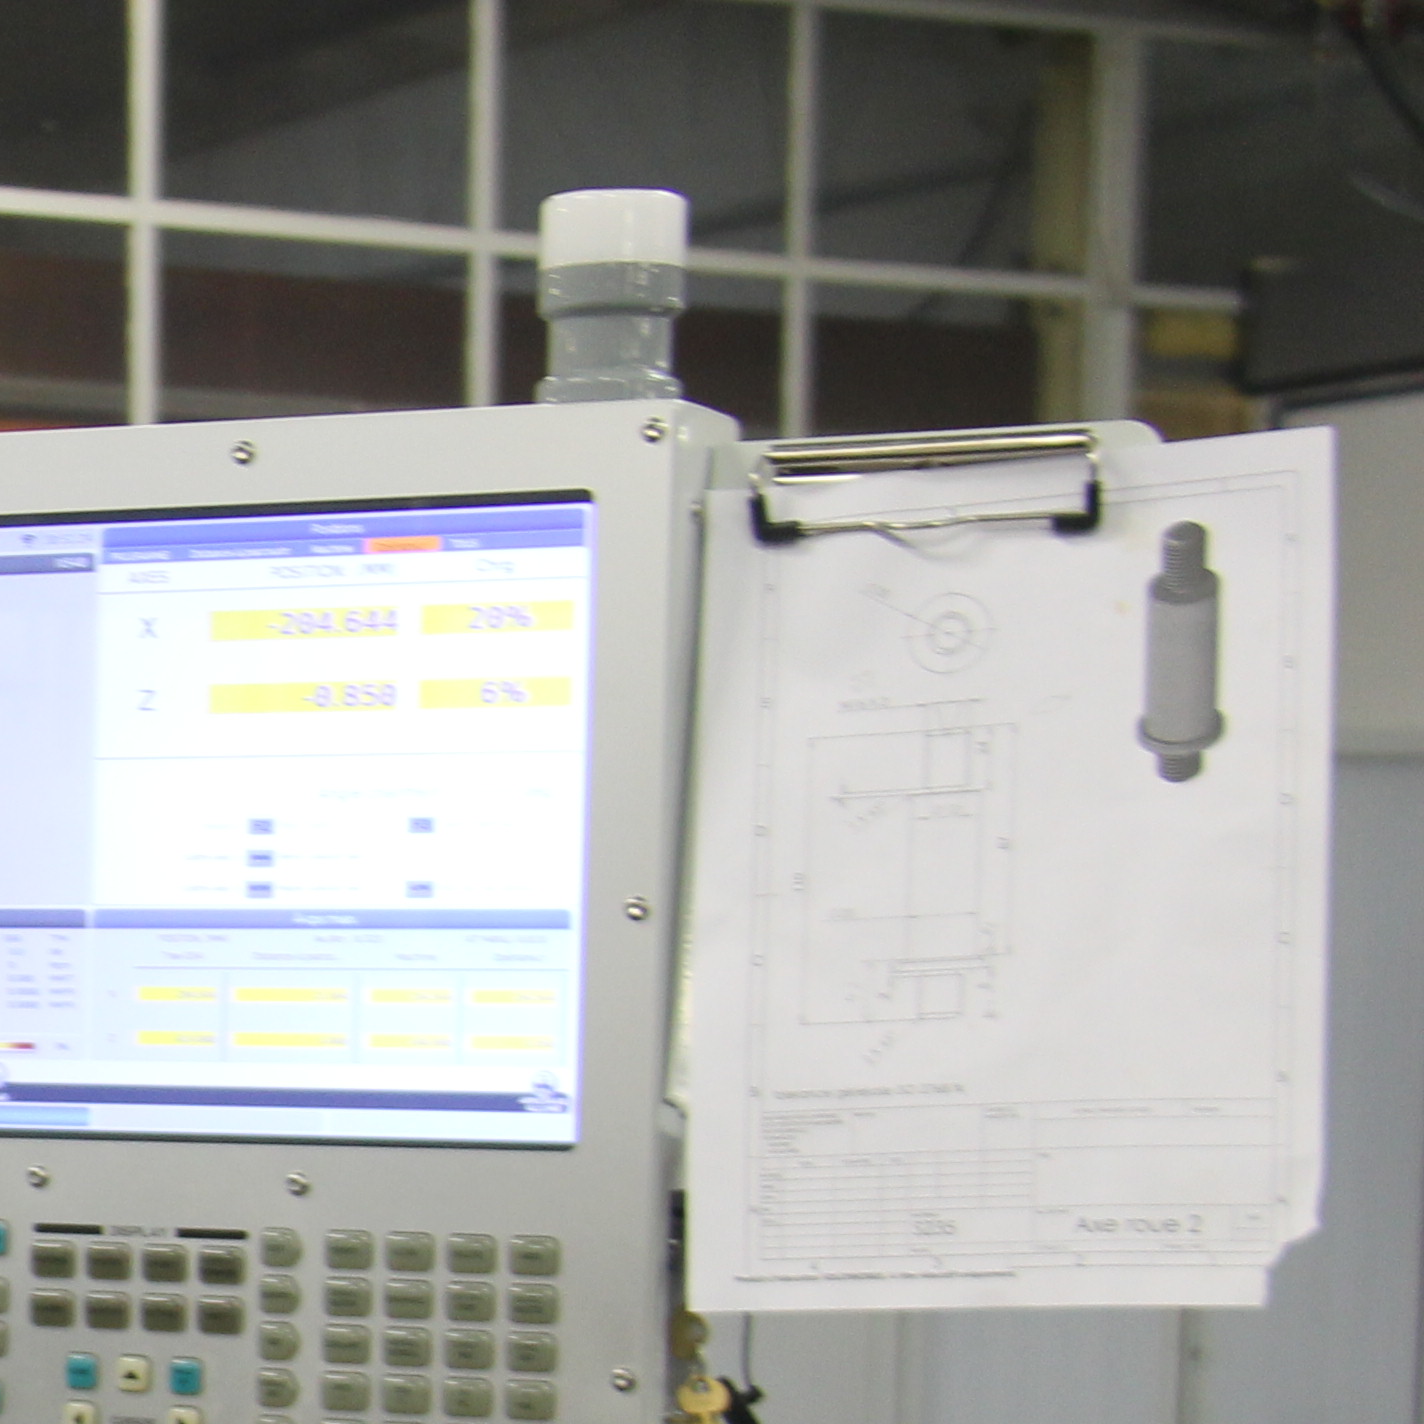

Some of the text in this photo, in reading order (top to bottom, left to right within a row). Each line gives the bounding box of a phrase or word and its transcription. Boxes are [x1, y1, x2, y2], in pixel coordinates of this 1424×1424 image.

[138, 616, 159, 639] X
[137, 688, 159, 712] Z
[1075, 1215, 1120, 1234] Axe
[1186, 1212, 1204, 1235] 2
